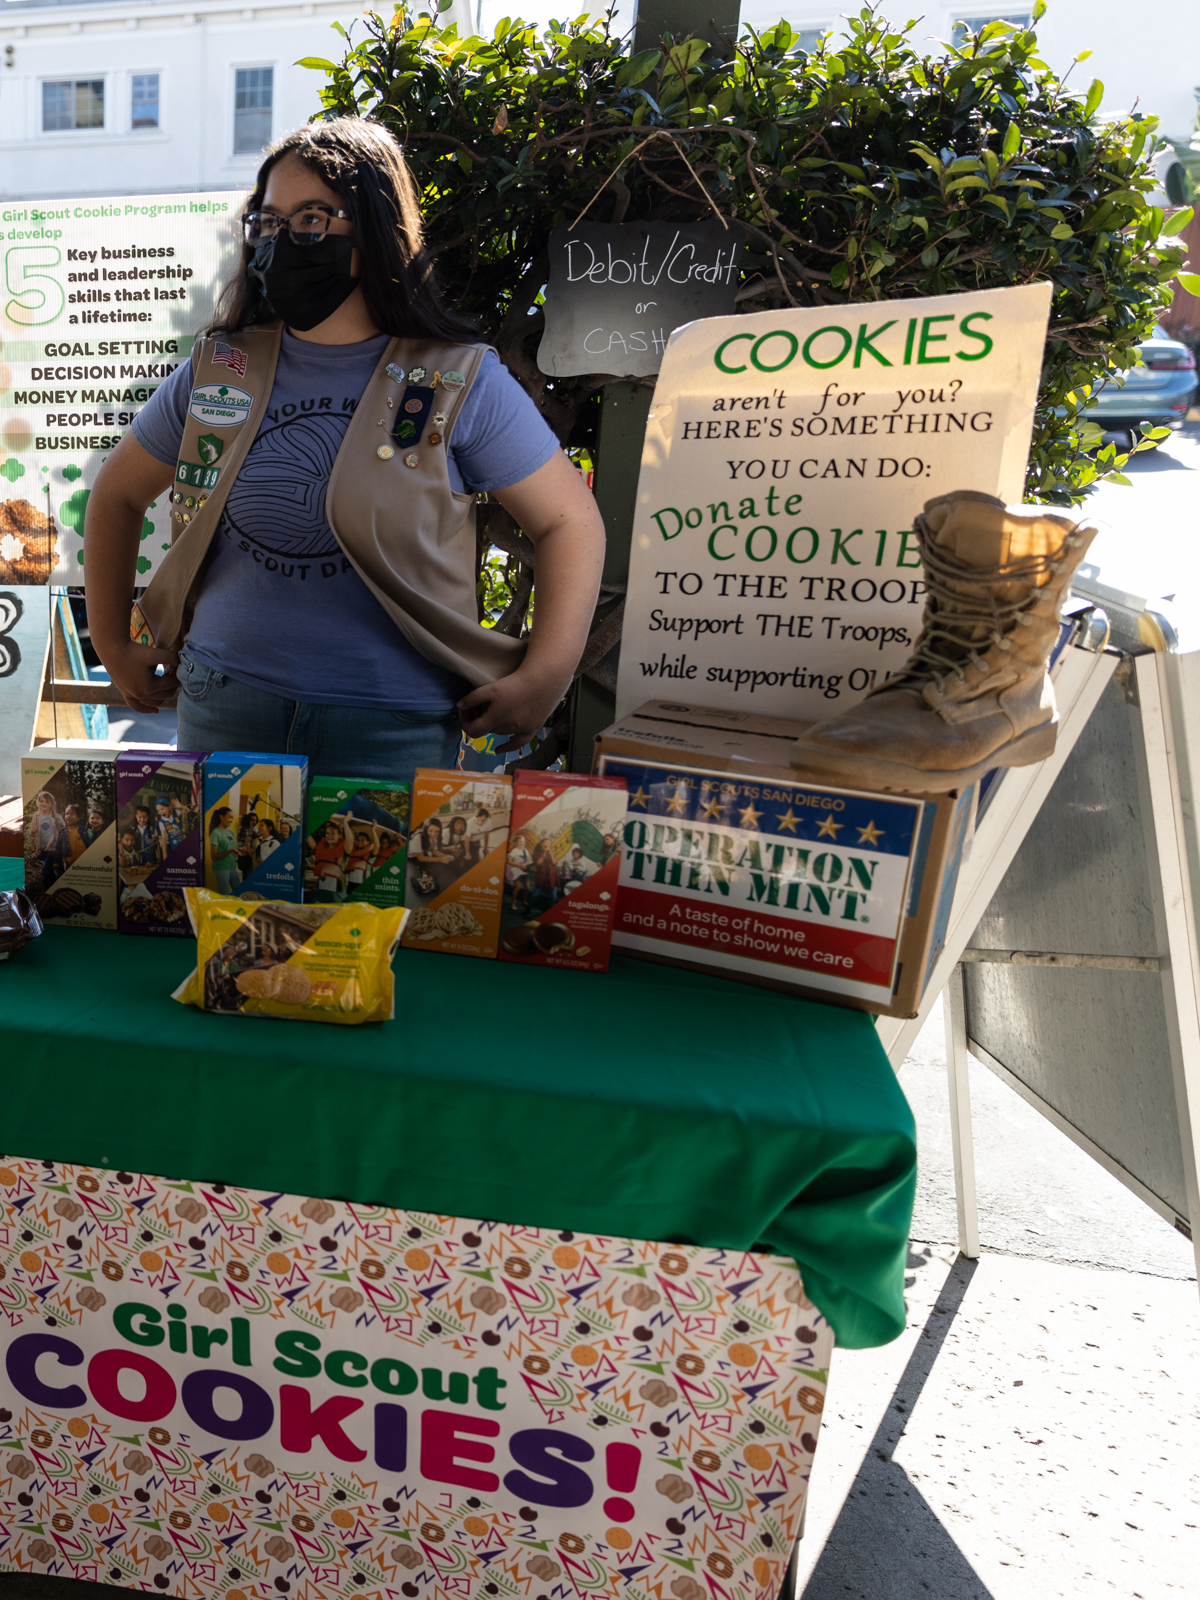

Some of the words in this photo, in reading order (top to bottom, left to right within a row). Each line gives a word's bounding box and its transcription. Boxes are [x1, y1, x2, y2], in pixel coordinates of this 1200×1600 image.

[2, 209, 28, 222] Girl
[30, 208, 70, 221] Scout
[73, 206, 121, 219] Cookie
[124, 203, 186, 218] Program
[189, 200, 229, 216] helps
[7, 227, 63, 243] develop
[67, 248, 97, 264] Key
[101, 245, 175, 261] business
[563, 230, 737, 286] Debit/Credit
[5, 245, 66, 326] 5
[68, 268, 99, 282] and
[102, 265, 193, 281] leadership
[68, 289, 111, 304] skills
[114, 288, 151, 302] that
[154, 286, 186, 300] last
[635, 301, 657, 314] or
[68, 313, 78, 324] a
[81, 309, 152, 324] lifetime:
[44, 342, 94, 357] GOAL
[98, 339, 178, 355] SETTING
[584, 327, 667, 355] CASH
[713, 311, 994, 375] COOKIES
[31, 366, 115, 380] DECISION
[120, 364, 179, 379] MAKIN
[14, 390, 78, 404] MONEY
[193, 392, 208, 401] GIRL
[208, 395, 236, 405] SCOUTS
[236, 397, 249, 406] USA
[267, 397, 333, 424] YOUR
[713, 389, 787, 412] aren't
[813, 383, 865, 416] for
[893, 379, 964, 414] you?
[46, 412, 115, 427] PEOPLE
[215, 409, 236, 418] DIEGO
[681, 416, 783, 441] HERE'S
[790, 411, 994, 437] SOMETHING
[726, 459, 791, 480] YOU
[799, 458, 868, 479] CAN
[875, 457, 932, 478] DO:
[650, 485, 803, 542] Donate
[238, 540, 311, 581] SCOUT
[320, 556, 355, 579] DA
[655, 571, 703, 596] TO
[713, 573, 789, 599] THE
[648, 608, 744, 642] Support
[755, 613, 813, 639] THE
[821, 616, 912, 650] Troops,
[639, 653, 698, 680] while
[705, 667, 842, 698] supporting
[666, 775, 699, 791] GIRL
[702, 780, 760, 800] SCOUTS
[762, 788, 792, 804] SAN
[795, 792, 846, 812] DIEGO
[623, 819, 879, 892] OPERATION
[626, 850, 735, 897] THIN
[669, 904, 682, 917] A
[685, 906, 729, 926] taste
[732, 914, 752, 931] of
[753, 919, 806, 942] home
[623, 910, 654, 929] and
[657, 919, 667, 931] a
[670, 919, 710, 940] note
[713, 926, 730, 943] to
[733, 930, 780, 954] show
[783, 942, 809, 960] we
[812, 948, 855, 969] care
[112, 1301, 252, 1368] Girl
[273, 1329, 507, 1412] Scout
[5, 1332, 642, 1523] COOKIES!
